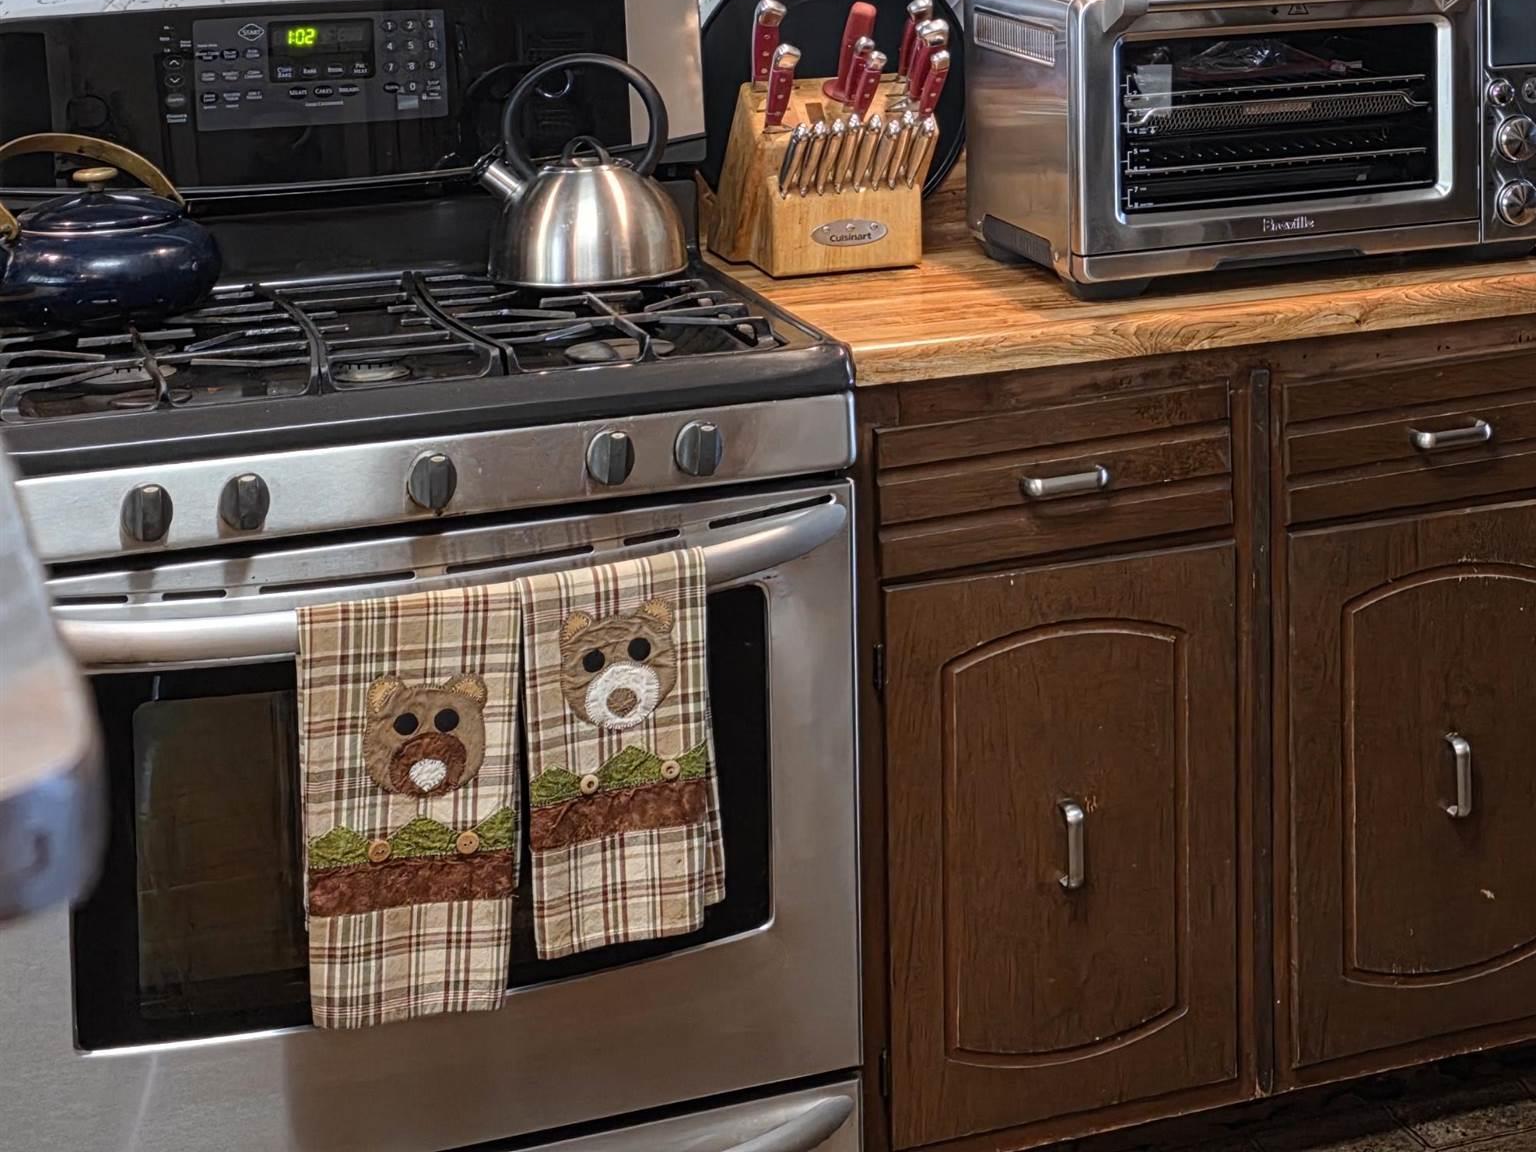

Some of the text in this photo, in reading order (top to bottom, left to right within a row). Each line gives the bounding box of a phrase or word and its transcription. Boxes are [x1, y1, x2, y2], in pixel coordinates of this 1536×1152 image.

[387, 22, 392, 30] 1
[407, 21, 413, 29] 2
[428, 20, 434, 28] 3
[288, 28, 316, 45] 1:02
[387, 42, 393, 50] 4
[408, 41, 414, 49] 5
[408, 62, 415, 70] 8
[429, 61, 436, 69] 9
[409, 82, 416, 90] 0
[829, 232, 872, 242] Cuisinart
